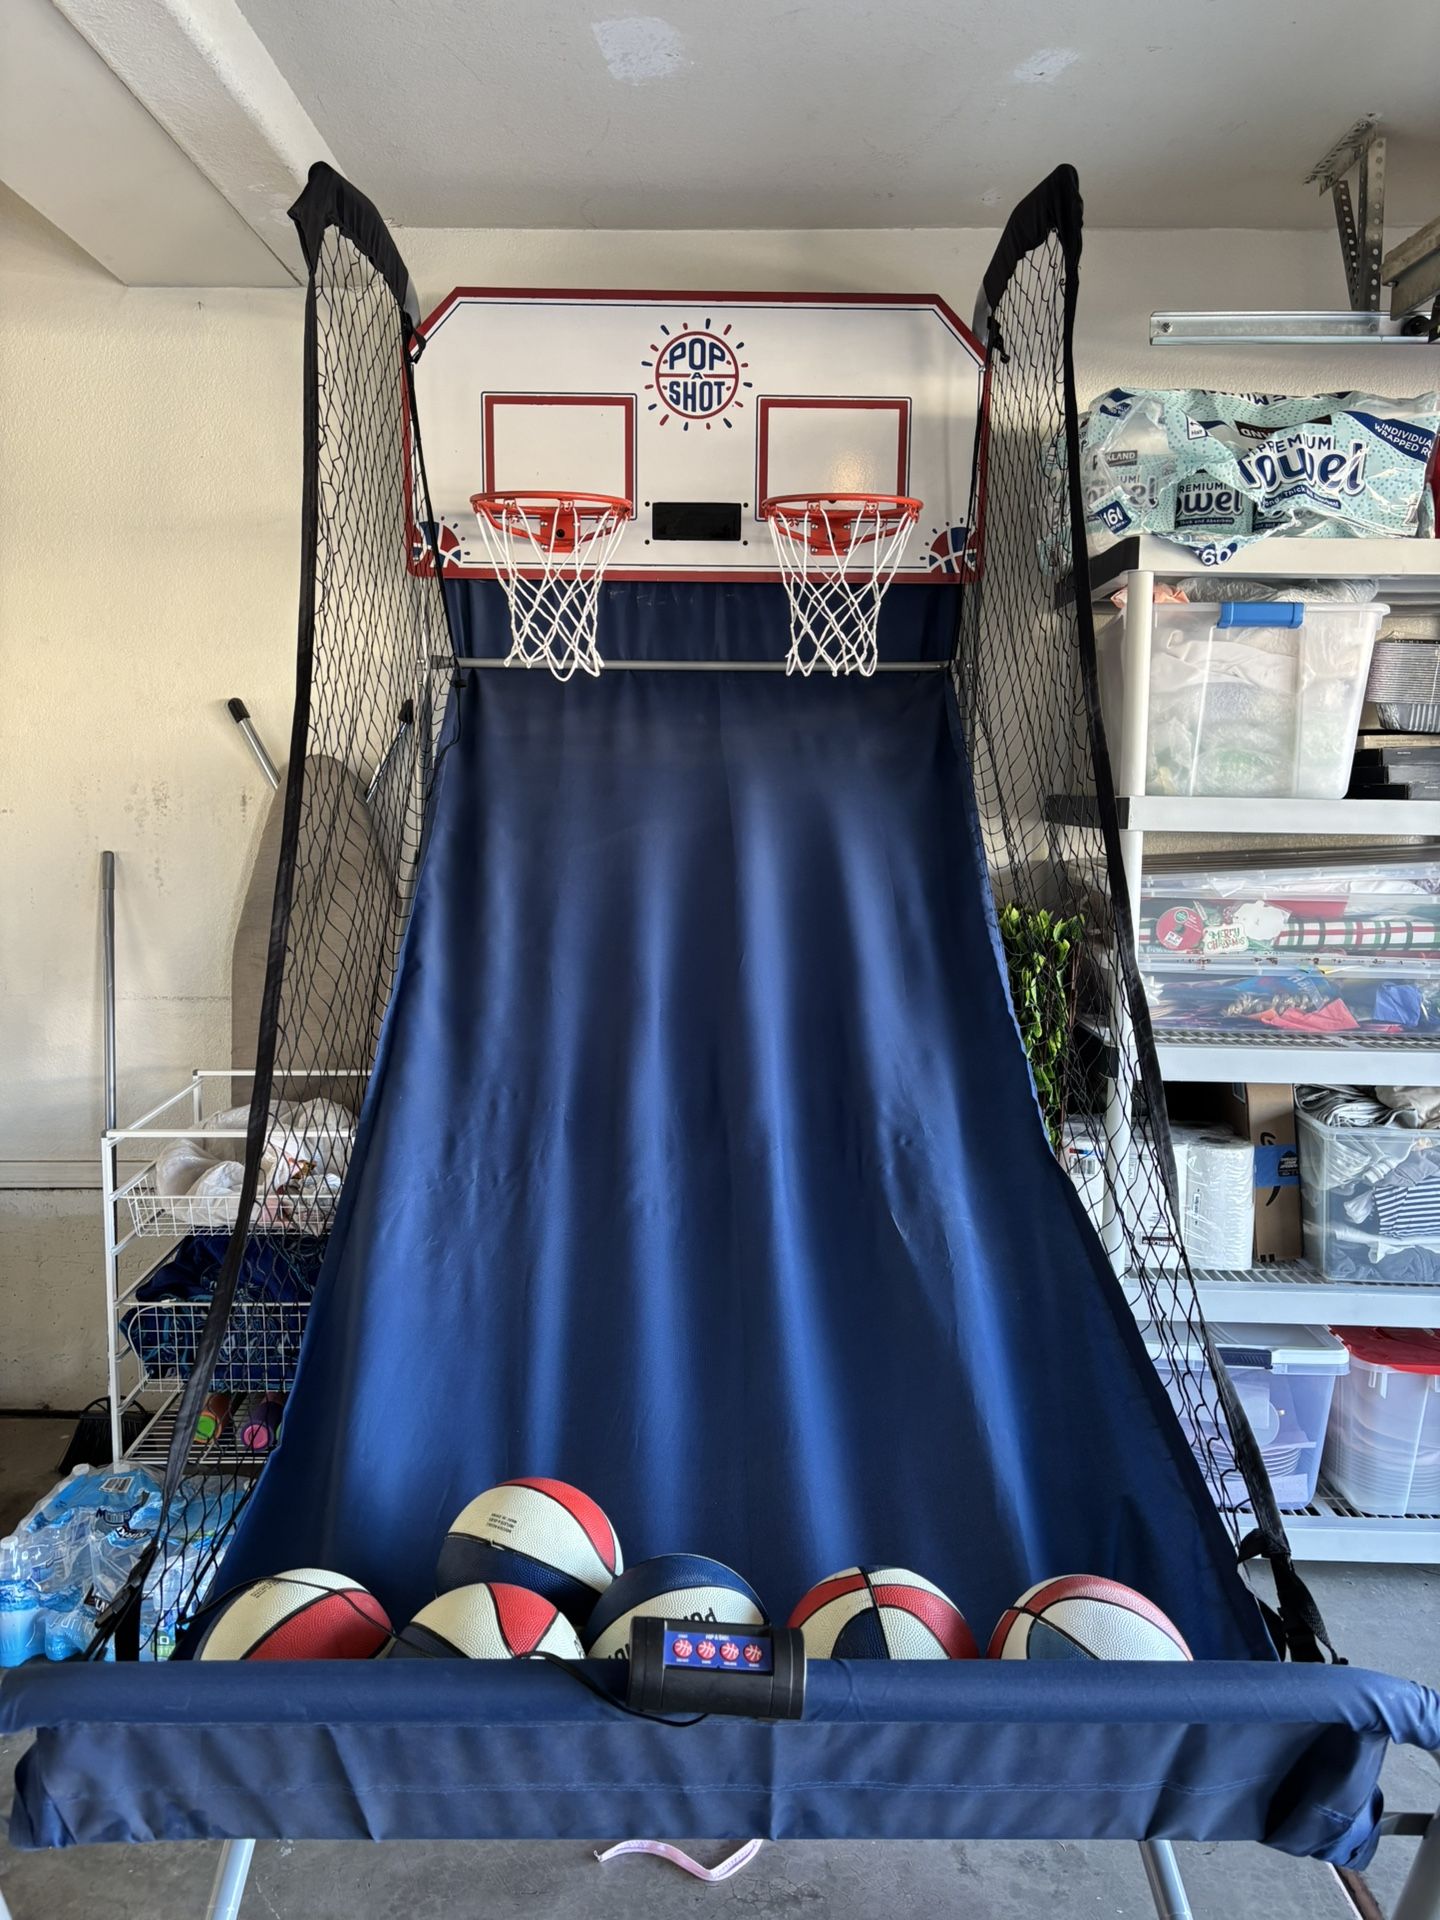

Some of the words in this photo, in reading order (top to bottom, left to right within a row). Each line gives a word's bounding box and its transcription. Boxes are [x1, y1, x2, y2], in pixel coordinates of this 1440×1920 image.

[669, 338, 726, 370] POP
[669, 381, 726, 412] SHOT
[1374, 423, 1419, 452] WRAPPED
